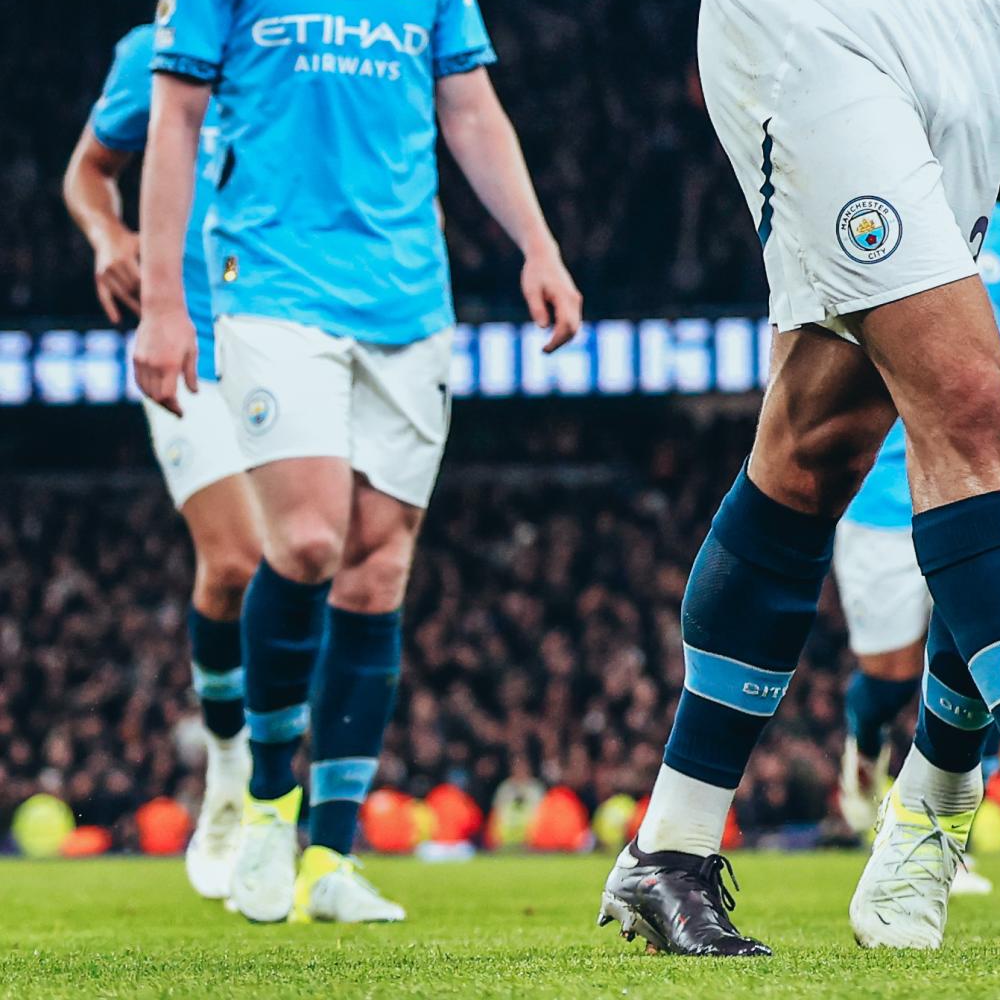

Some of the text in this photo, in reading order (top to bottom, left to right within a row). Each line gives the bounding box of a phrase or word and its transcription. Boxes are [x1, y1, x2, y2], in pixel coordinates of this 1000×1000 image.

[252, 13, 430, 57] ETIHAD
[294, 53, 401, 81] AIRWAYS
[840, 201, 889, 231] MANCHESTER
[868, 247, 886, 260] CITY
